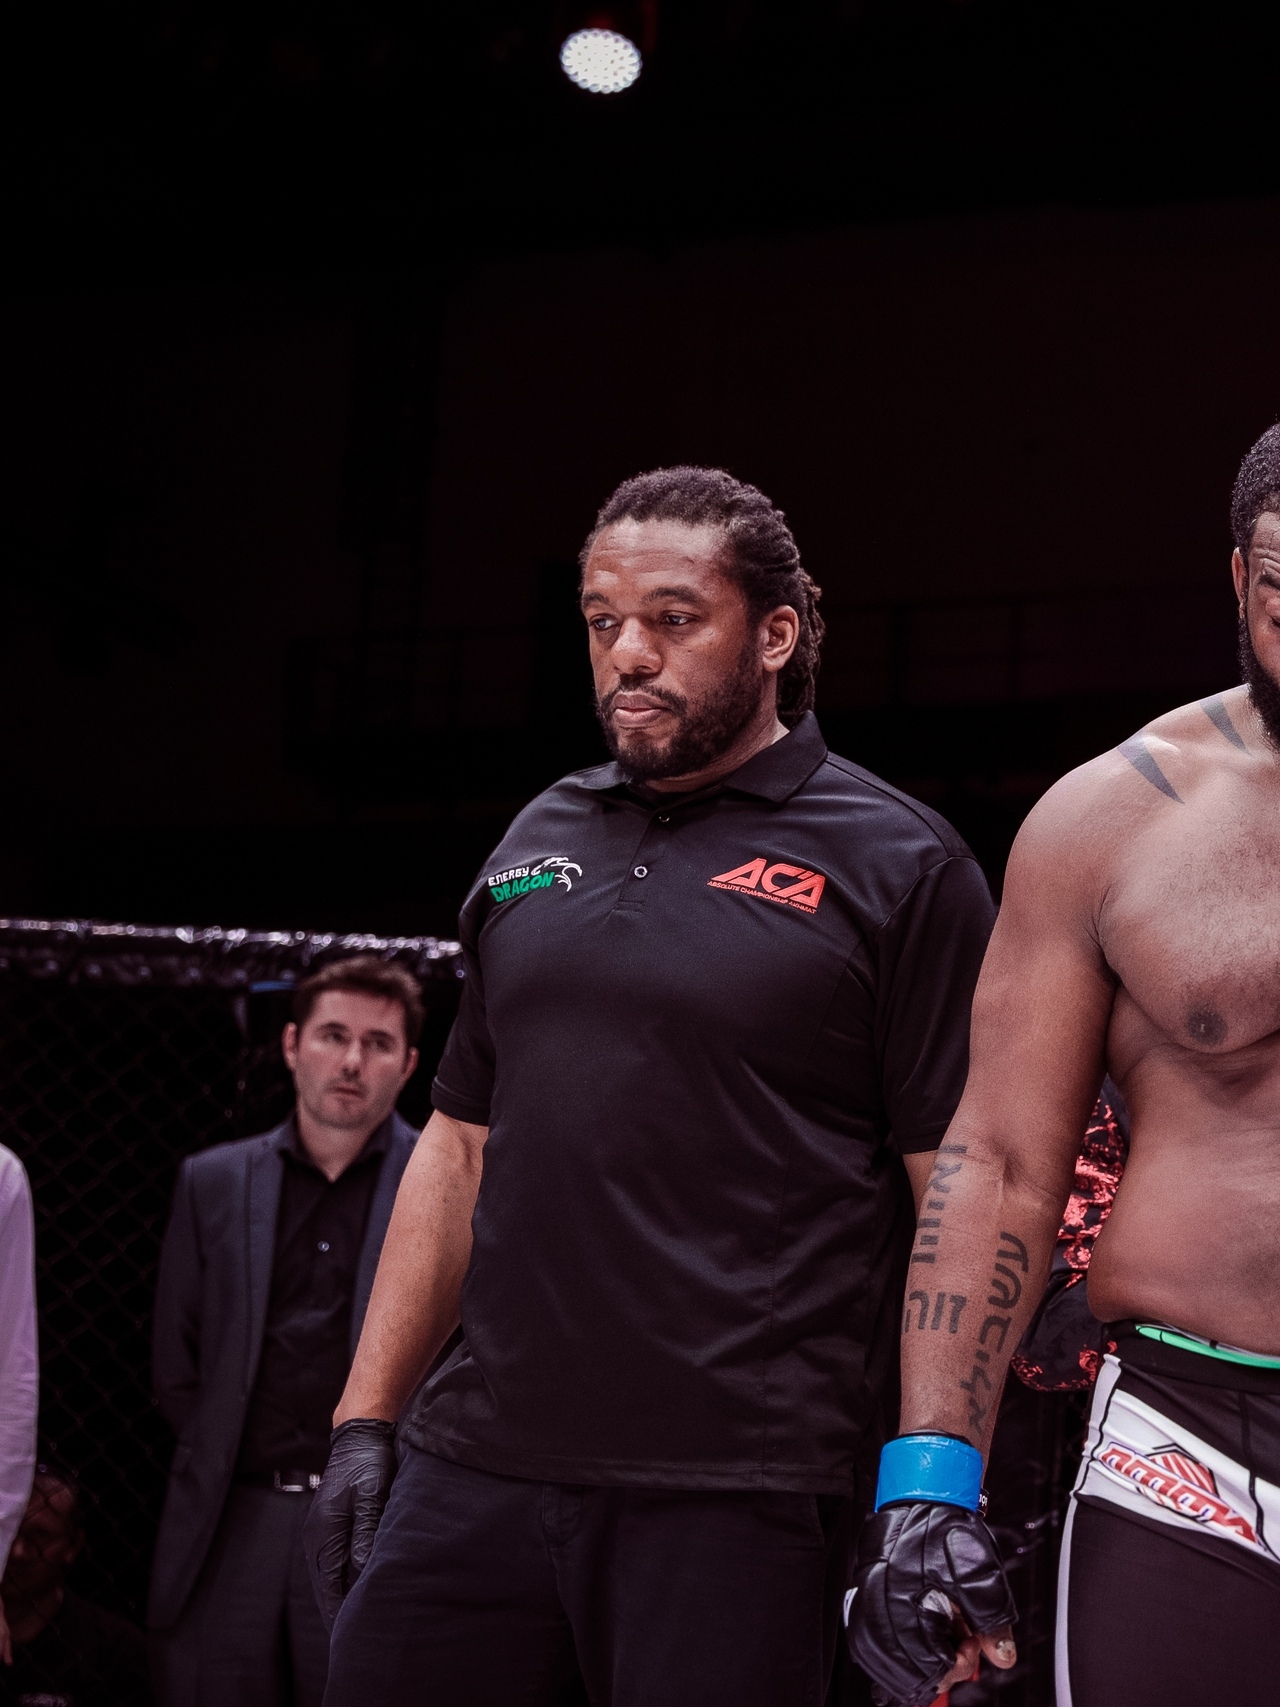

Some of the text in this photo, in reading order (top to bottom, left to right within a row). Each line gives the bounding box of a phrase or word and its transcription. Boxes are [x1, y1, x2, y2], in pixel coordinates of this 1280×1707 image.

[488, 866, 530, 887] ENERGY
[490, 871, 555, 902] DRAGON
[711, 858, 826, 908] ACA
[707, 881, 740, 892] ABSOLUTE
[740, 886, 788, 904] CHAMPIONSHIP
